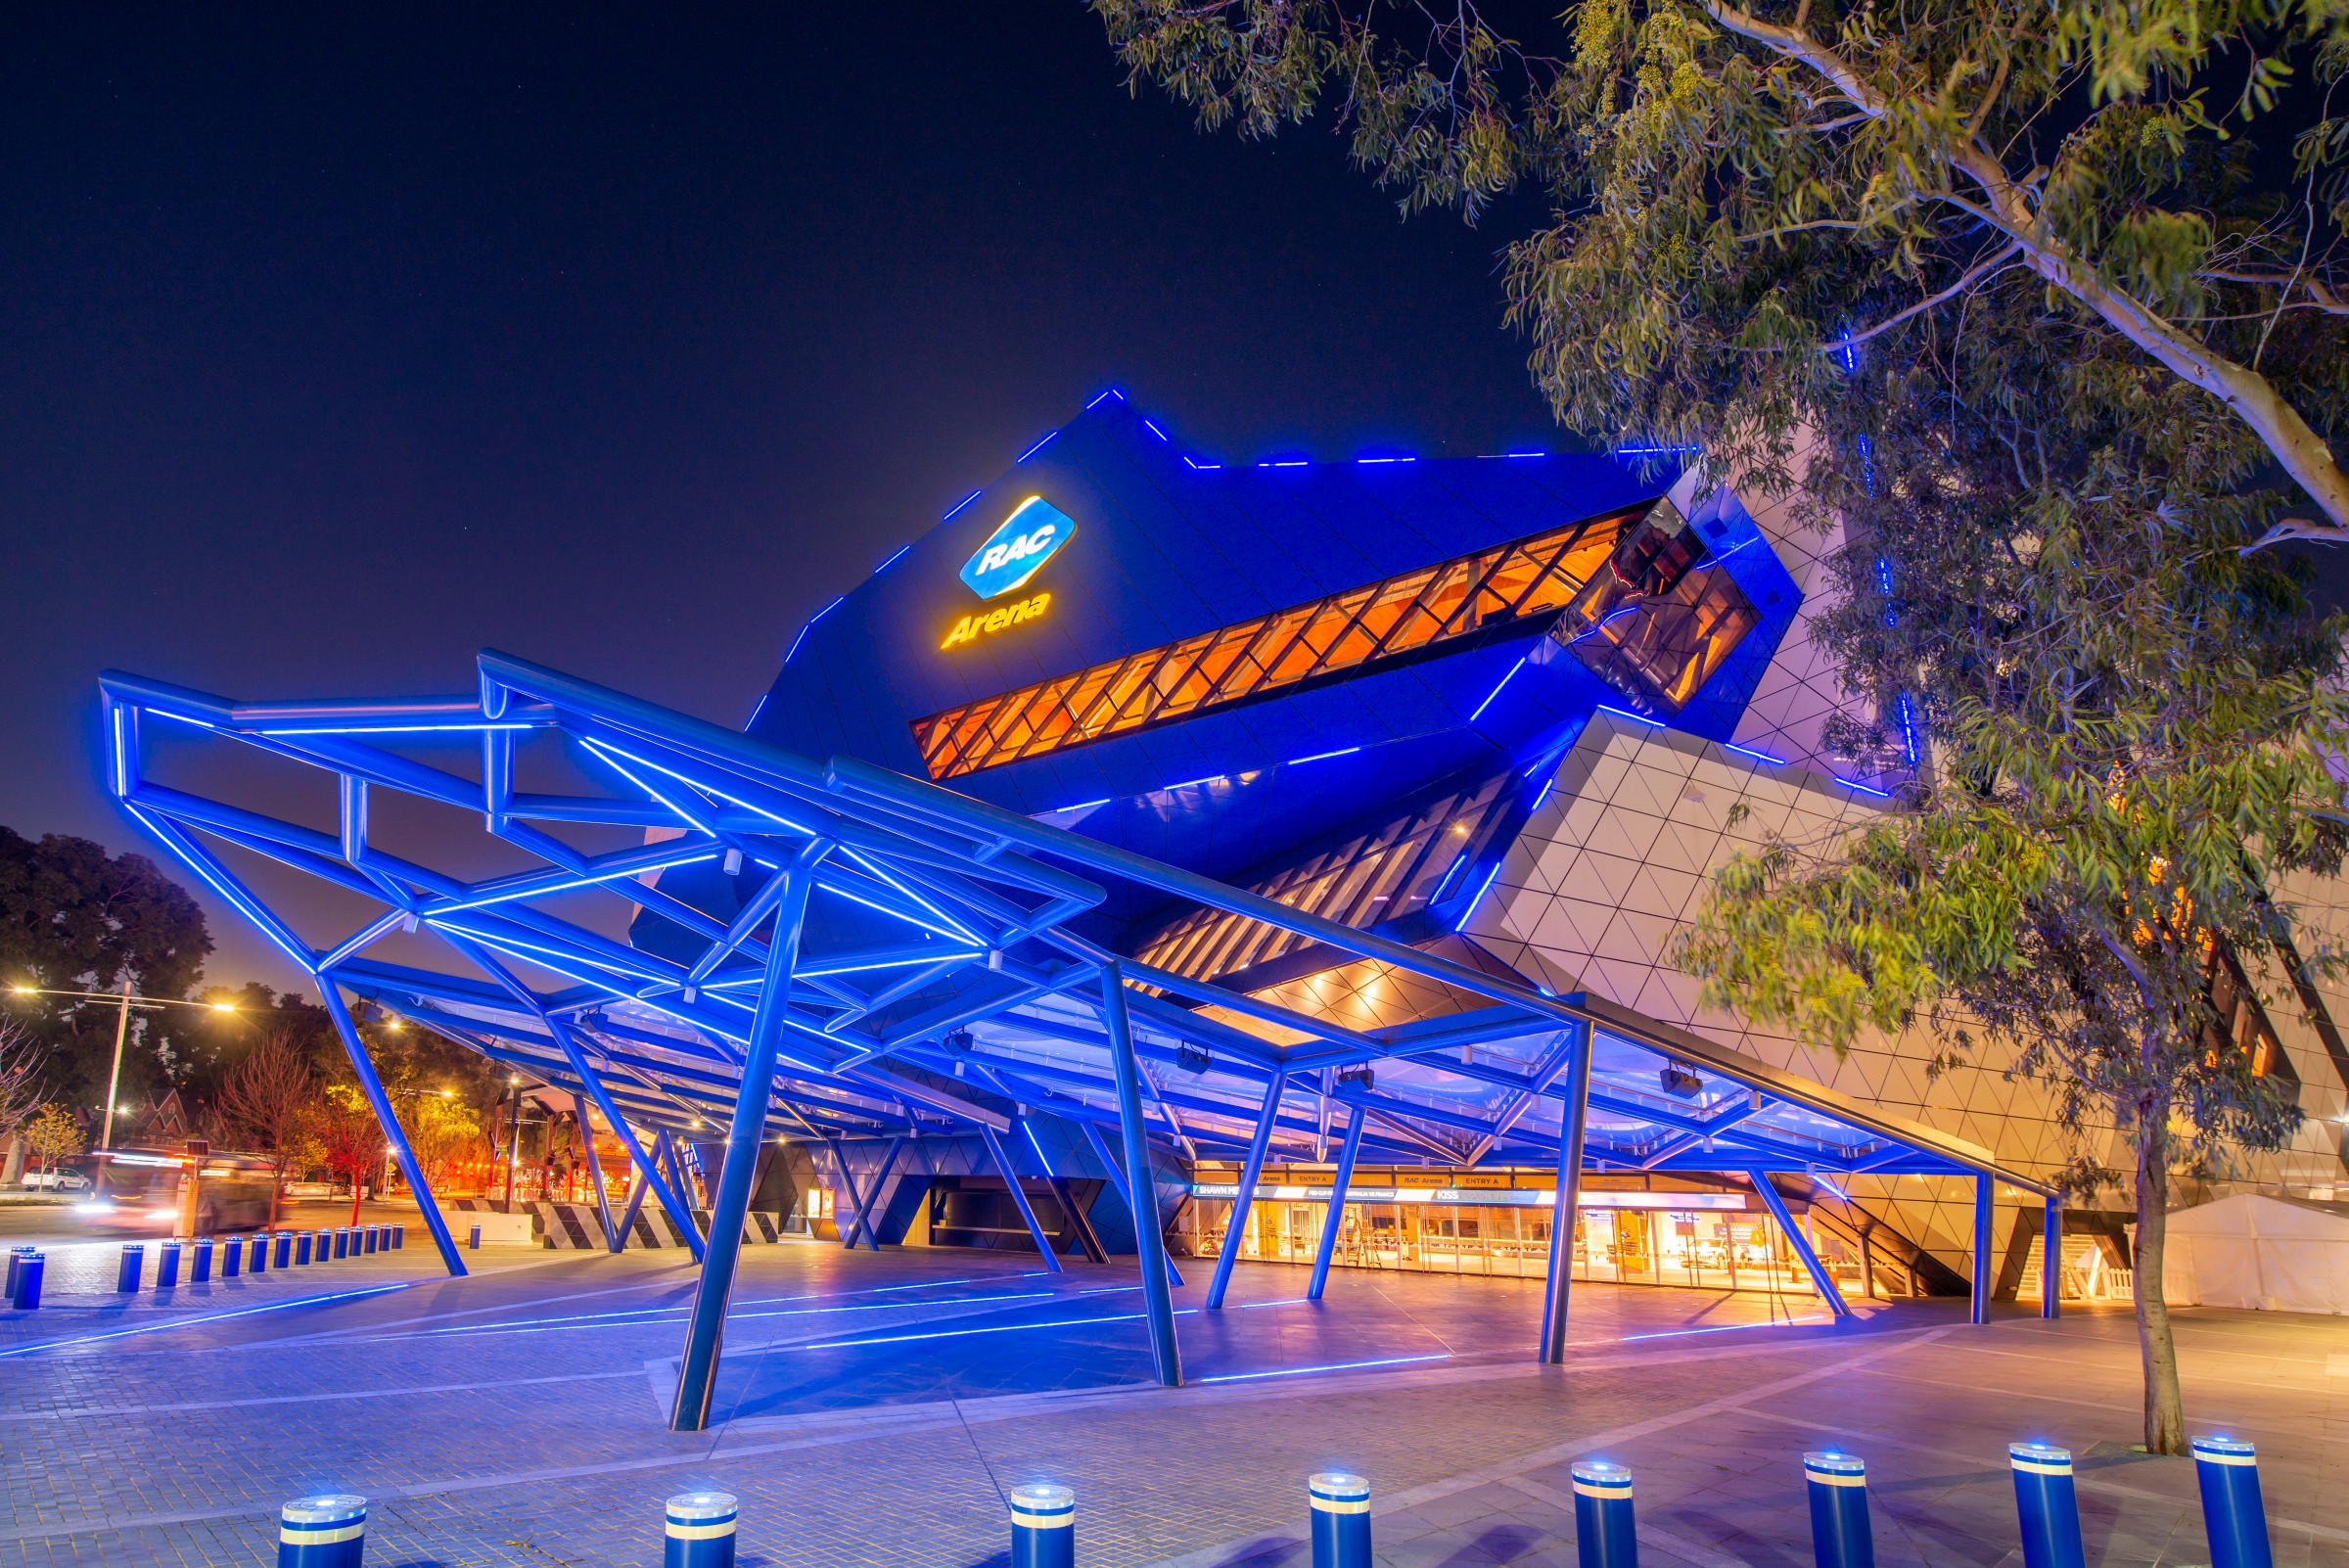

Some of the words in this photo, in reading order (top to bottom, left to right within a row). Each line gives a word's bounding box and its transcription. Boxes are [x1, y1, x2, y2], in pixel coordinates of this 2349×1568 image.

[975, 524, 1056, 576] RAC
[940, 593, 1051, 650] Arena
[1199, 1186, 1227, 1195] SHAWN
[1437, 1190, 1459, 1200] KISS
